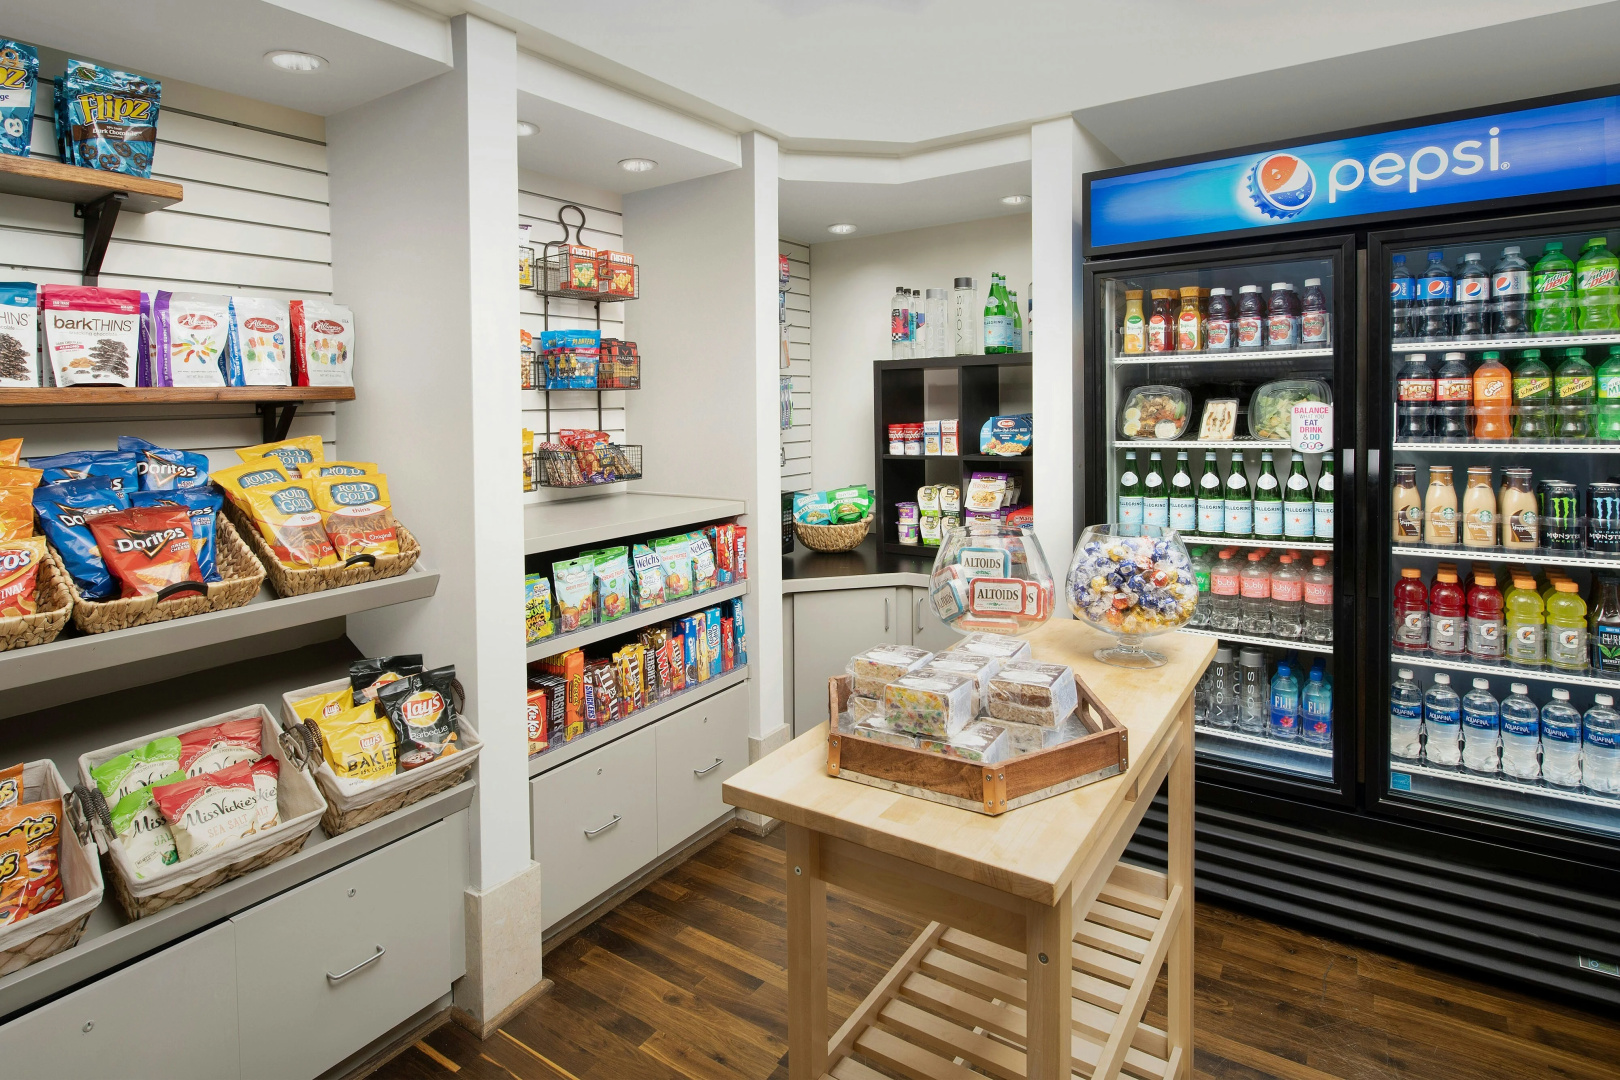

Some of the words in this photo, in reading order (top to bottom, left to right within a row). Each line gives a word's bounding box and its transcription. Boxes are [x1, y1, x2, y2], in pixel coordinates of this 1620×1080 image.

[77, 92, 151, 127] Flipz
[1328, 126, 1501, 204] pepsi
[54, 315, 132, 332] barkTHINS
[137, 461, 197, 478] Doritos
[276, 488, 306, 500] ROLD
[338, 482, 371, 492] ROLD
[336, 490, 377, 503] GOLD
[279, 498, 313, 512] GOLD
[117, 527, 186, 553] Doritos
[635, 554, 660, 569] Welch's
[963, 557, 1001, 569] ALTOIDS
[977, 588, 1019, 601] ALTOIDS
[1216, 666, 1224, 716] VOSS
[1247, 671, 1255, 722] VOSS
[406, 695, 440, 720] Lay's
[553, 683, 565, 732] HERSHEY'S
[585, 685, 596, 720] SNICKERS
[1274, 695, 1292, 710] FIJI
[1308, 701, 1325, 715] FIJI
[1393, 707, 1415, 717] AQUAFINA
[1429, 712, 1453, 722] AQUAFINA
[1466, 716, 1490, 727] AQUAFINA
[1505, 722, 1530, 733] AQUAFINA
[410, 725, 449, 740] Barbecue
[1543, 726, 1569, 739] AQUAFINA
[1588, 733, 1616, 745] AQUAFINA
[361, 734, 381, 748] Lay's
[256, 805, 269, 818] ALT
[185, 809, 219, 831] Miss
[207, 826, 225, 838] SEA
[228, 813, 249, 831] SALT
